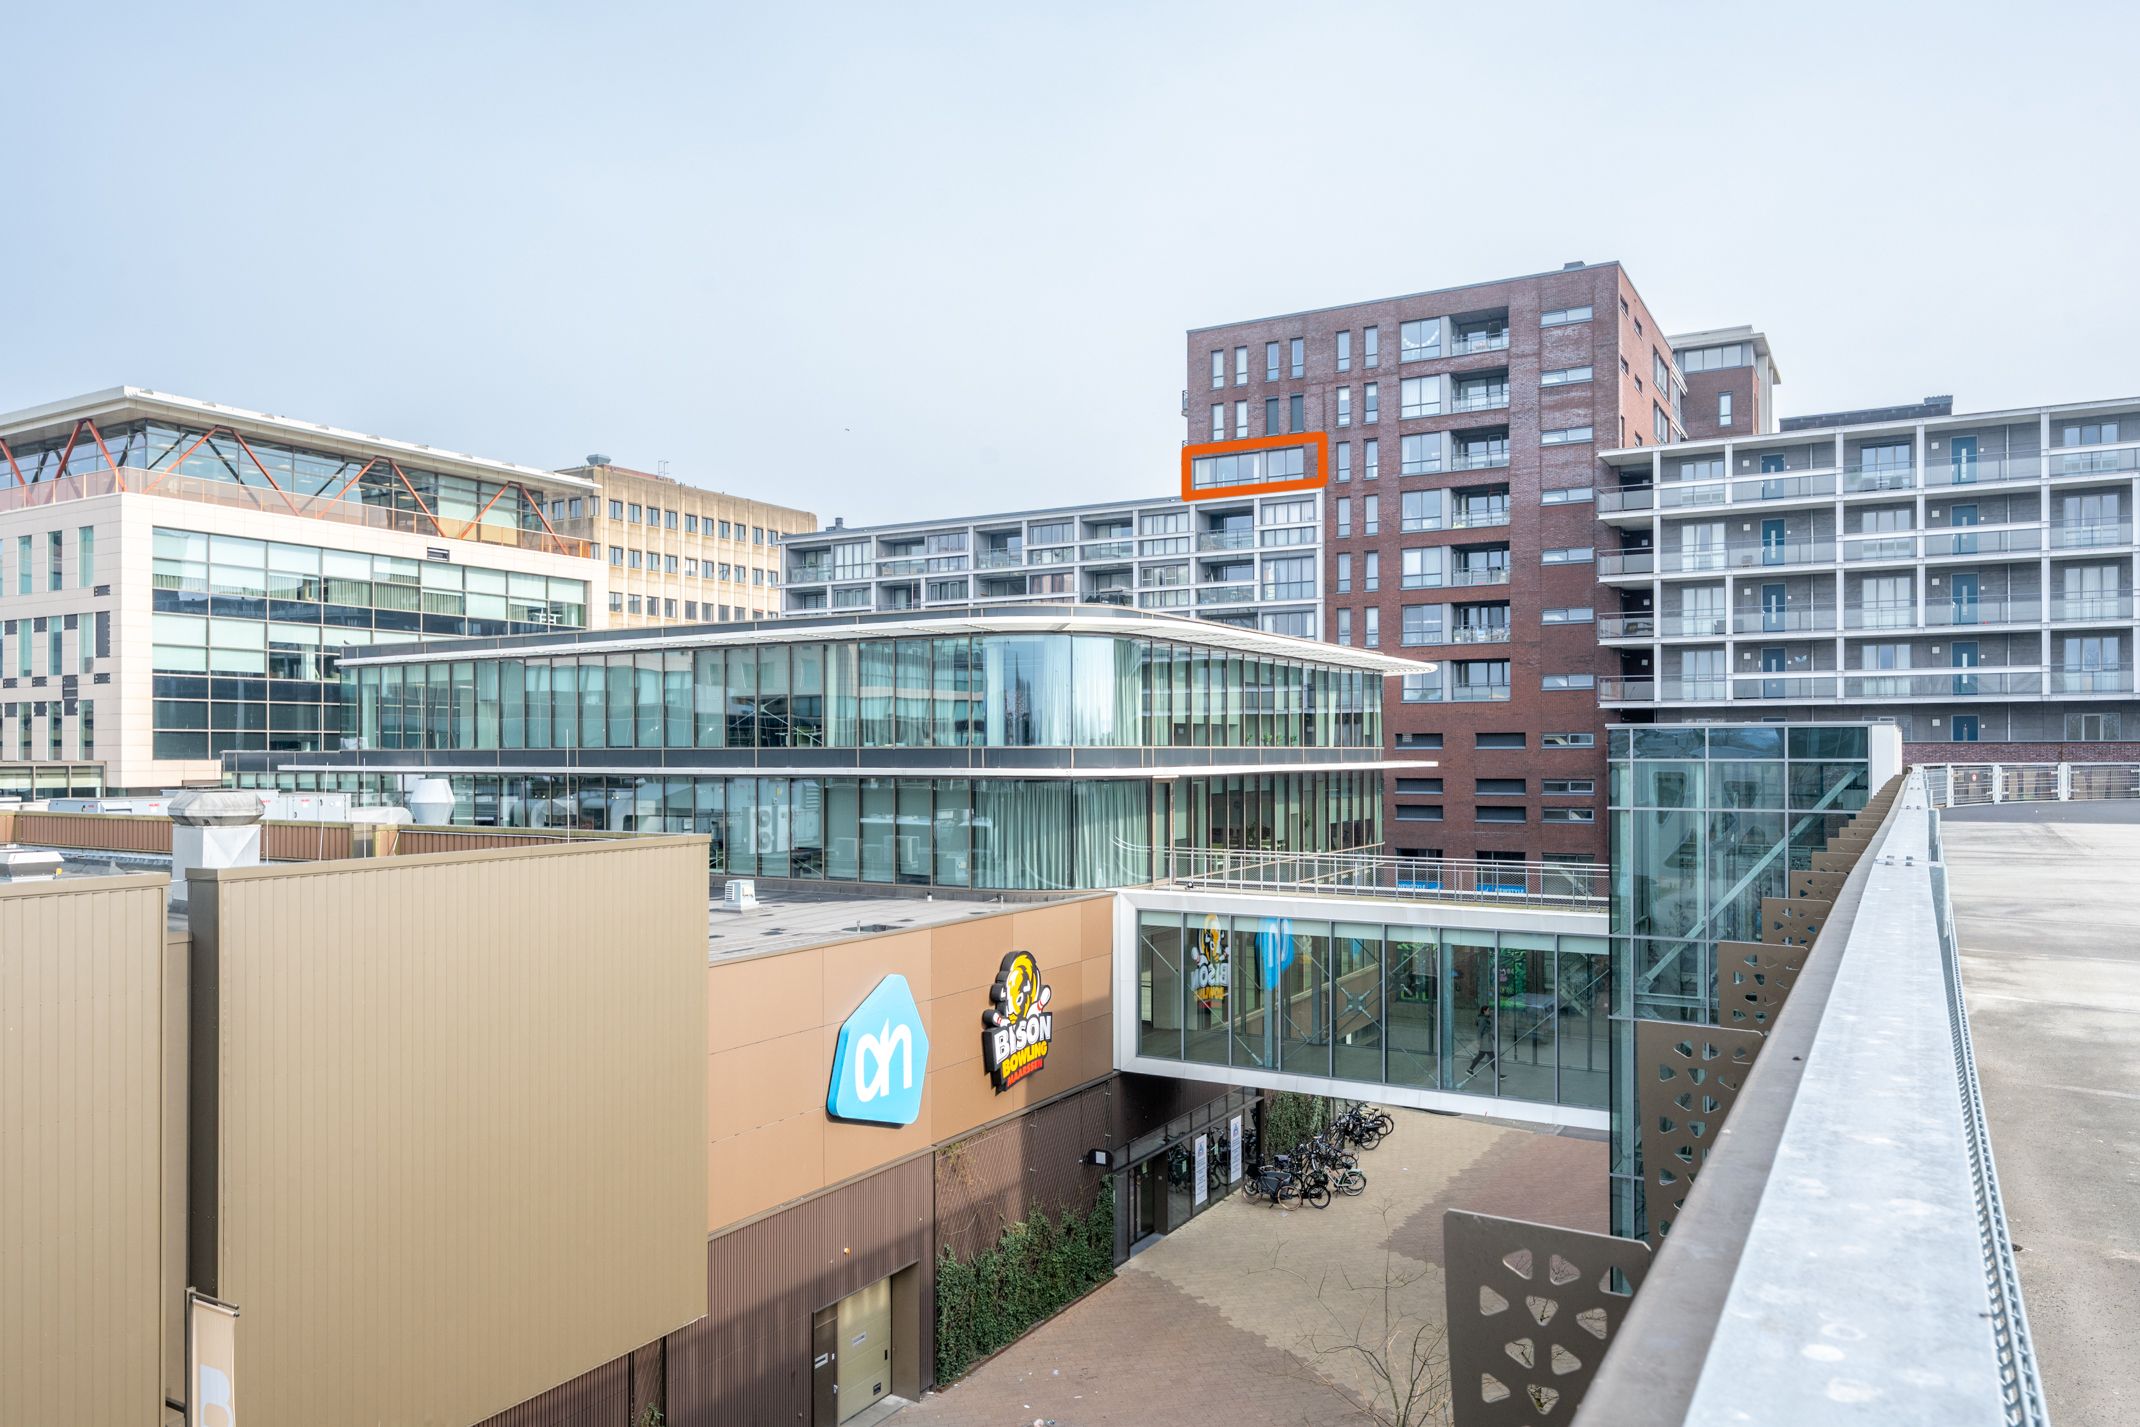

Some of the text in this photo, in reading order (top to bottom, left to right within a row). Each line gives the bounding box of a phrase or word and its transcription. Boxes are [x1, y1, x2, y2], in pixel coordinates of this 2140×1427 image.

[993, 1015, 1052, 1064] BISON
[1002, 1040, 1048, 1078] BOWLING
[1007, 1058, 1043, 1087] MAARSSEN
